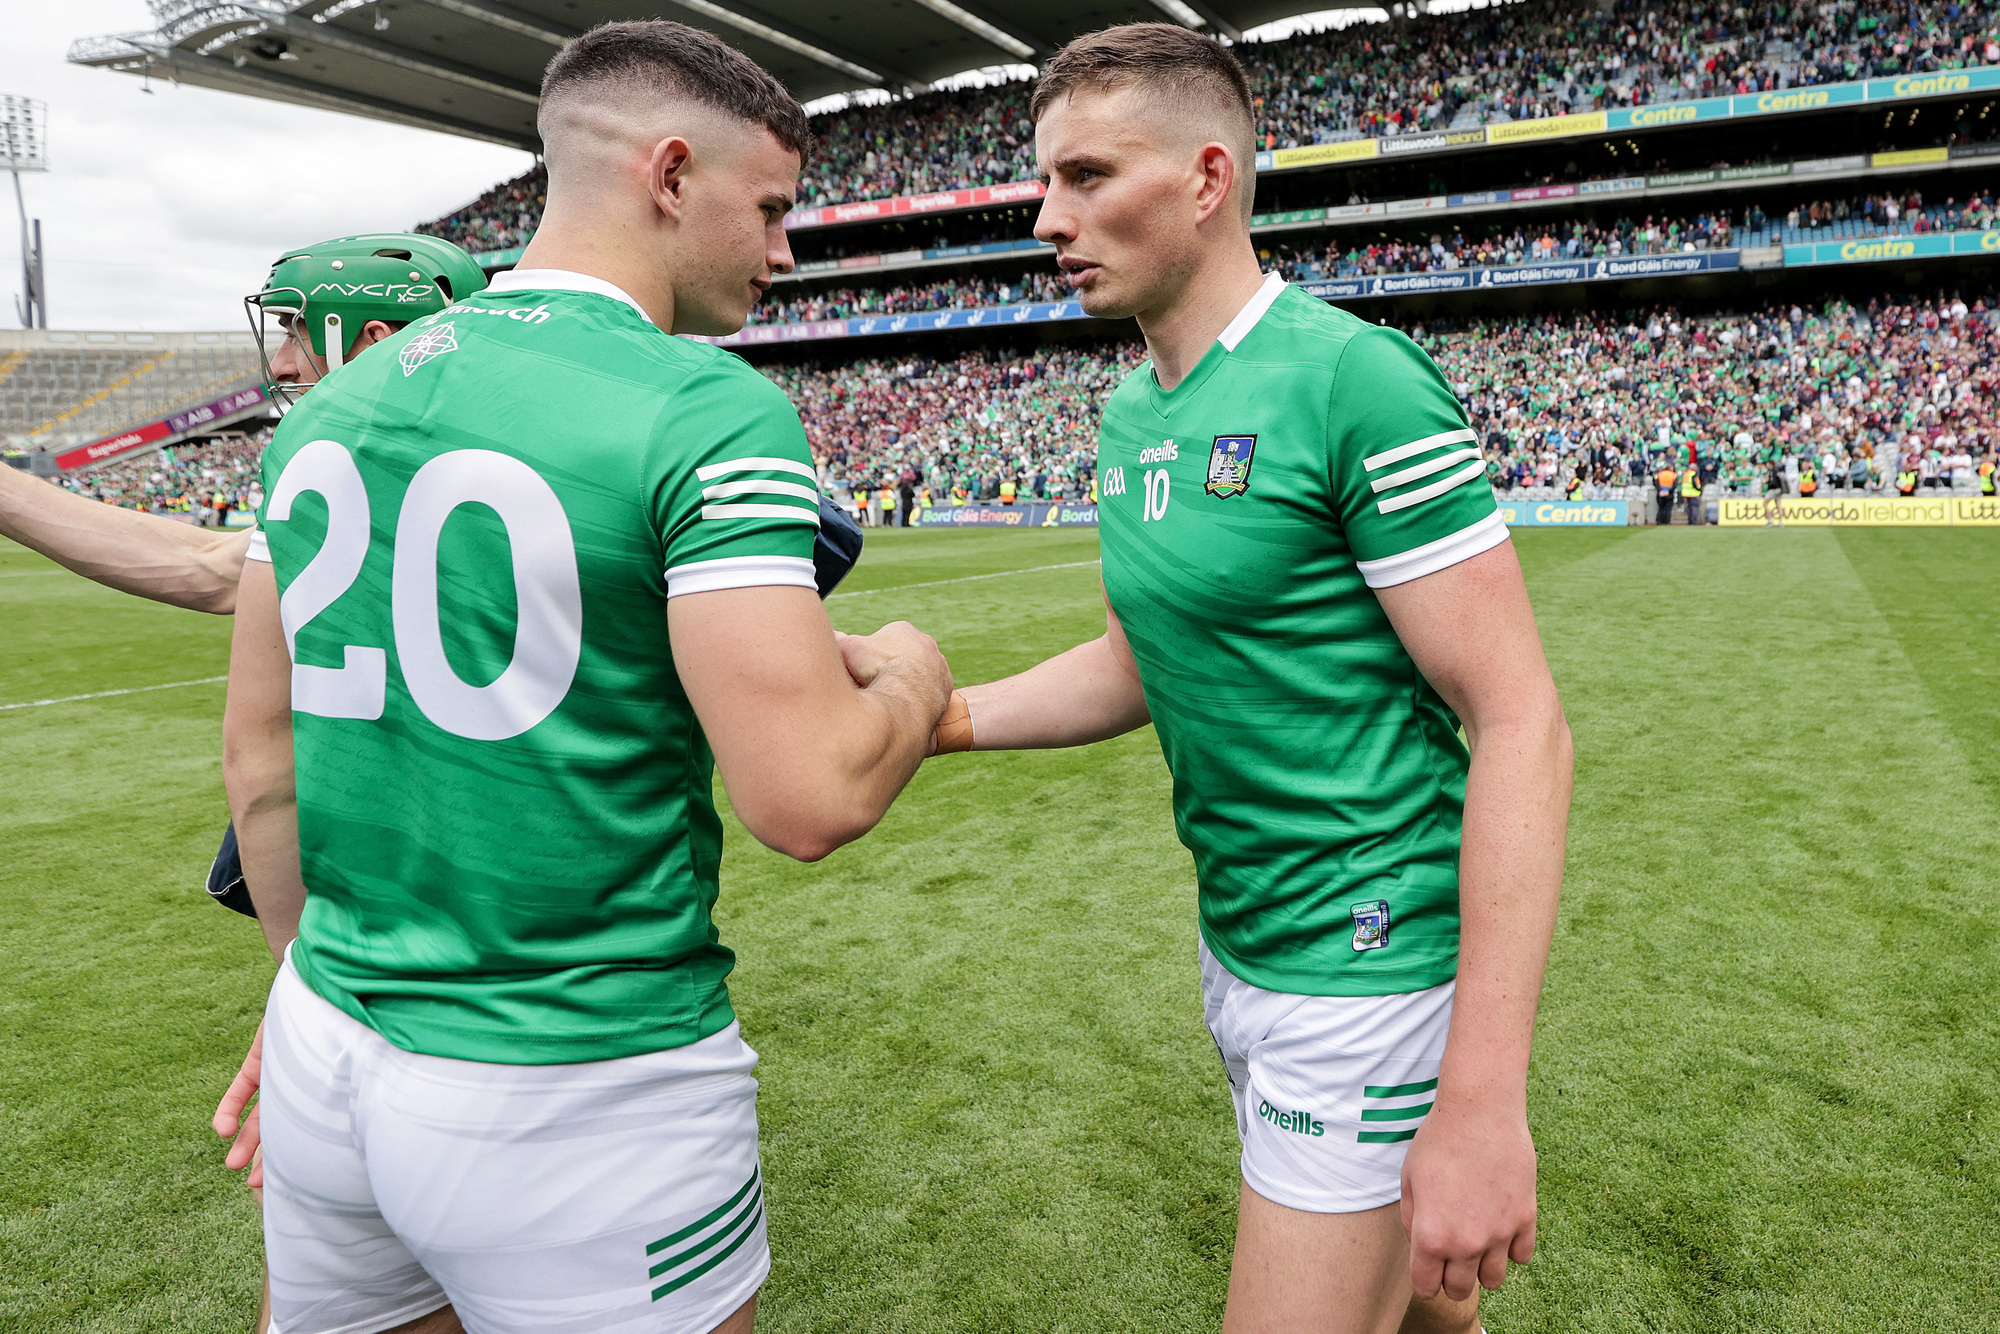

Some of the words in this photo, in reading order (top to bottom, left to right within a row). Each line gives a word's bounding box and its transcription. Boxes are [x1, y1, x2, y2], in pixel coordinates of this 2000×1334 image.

[1894, 74, 1970, 97] Centra
[1758, 90, 1829, 111] Centra
[1630, 105, 1697, 126] Centra
[1381, 134, 1447, 154] Littlewoods
[1447, 130, 1485, 145] Ireland
[1840, 240, 1915, 260] Centra
[1494, 271, 1518, 283] Bord
[1543, 267, 1579, 280] Energy
[1609, 261, 1636, 274] Bord
[1662, 257, 1701, 271] Energy
[1326, 283, 1358, 297] Energy
[1384, 279, 1408, 291] Bord
[1431, 275, 1465, 288] Energy
[234, 389, 261, 408] AIB
[187, 406, 215, 425] AIB
[87, 434, 143, 459] SuperValu
[1143, 468, 1170, 522] 10
[922, 509, 953, 523] Bord
[980, 509, 1024, 526] Energy
[1061, 508, 1094, 523] Bord
[1535, 504, 1617, 523] Centra
[1863, 501, 1945, 520] Ireland
[266, 439, 583, 741] 20
